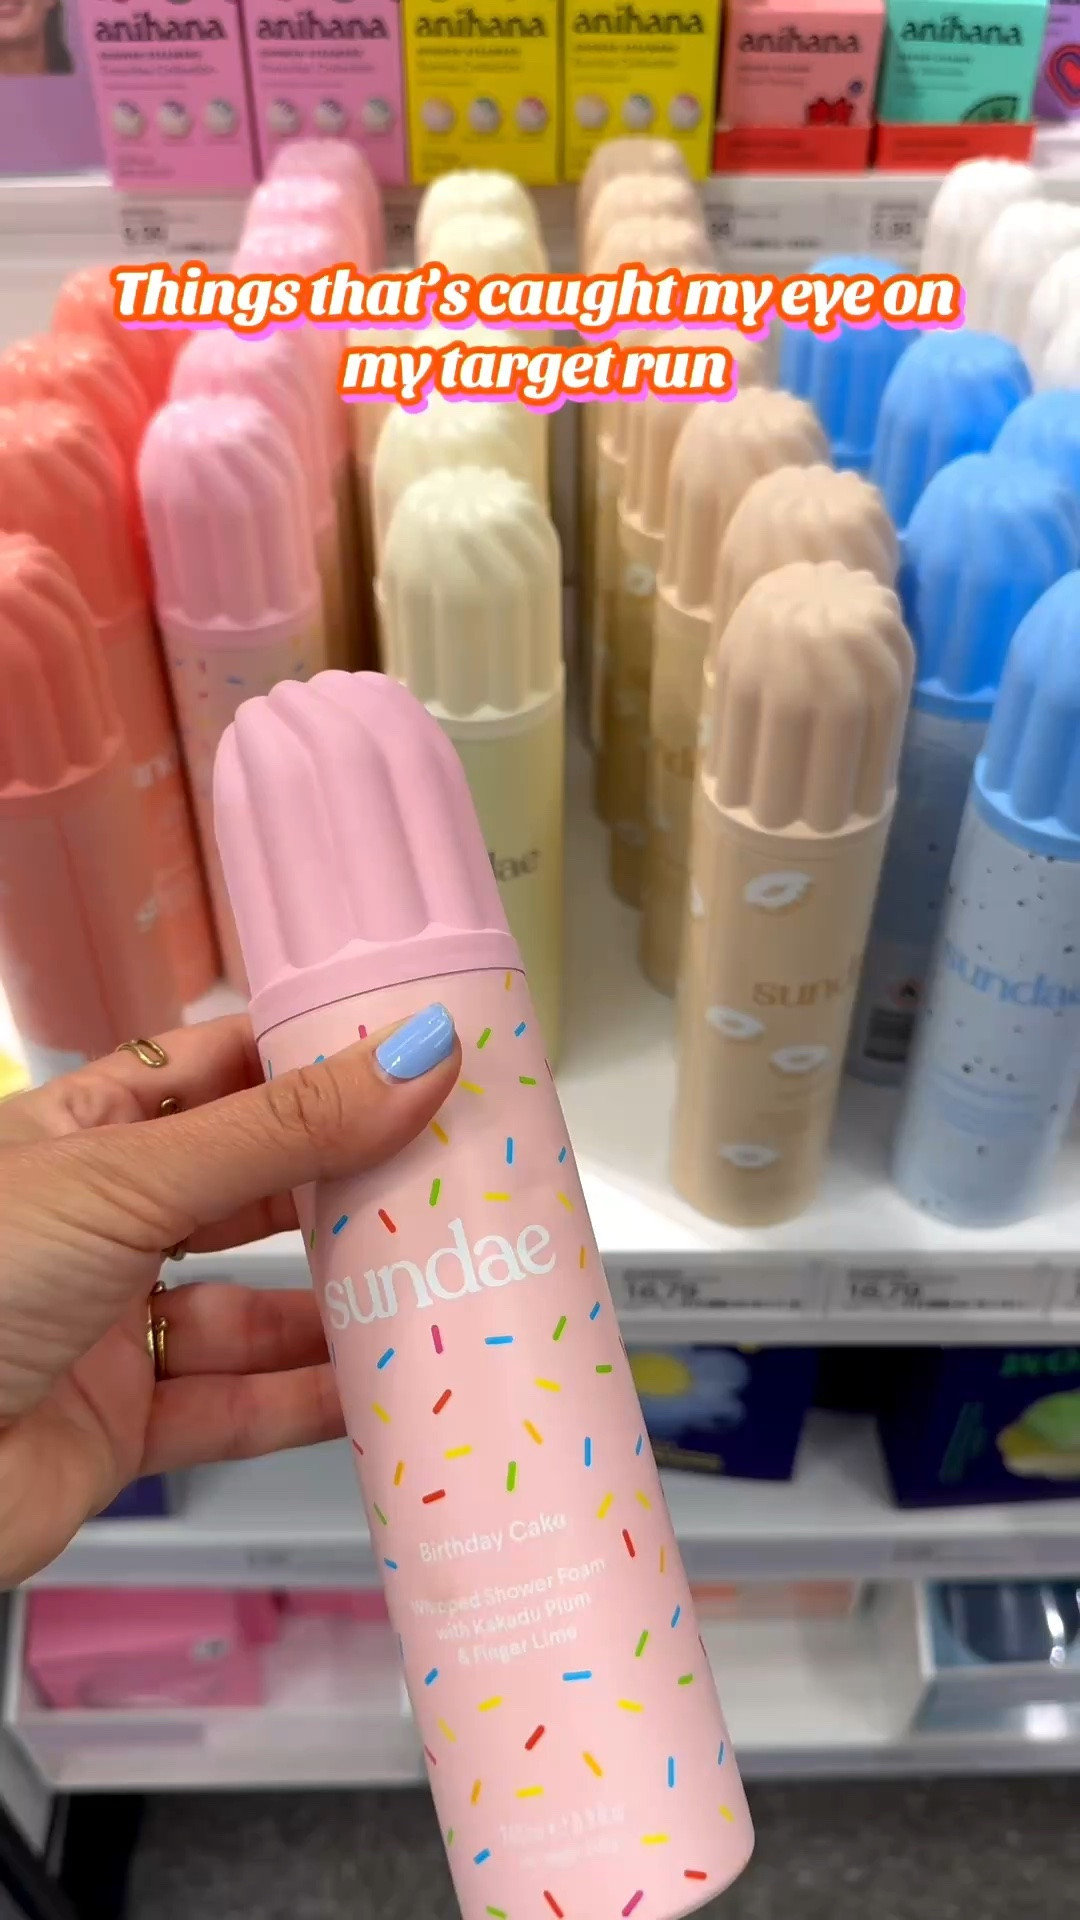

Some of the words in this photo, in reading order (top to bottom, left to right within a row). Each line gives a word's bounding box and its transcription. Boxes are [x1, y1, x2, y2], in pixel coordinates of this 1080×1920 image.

[95, 10, 227, 42] anihana
[257, 10, 390, 40] anihana
[415, 7, 547, 37] anihana
[574, 5, 704, 34] anihana
[900, 13, 1023, 46] anihana
[740, 25, 862, 53] anihana
[324, 1217, 557, 1330] sundae
[419, 1531, 504, 1563] Birthday
[509, 1512, 568, 1542] Cake
[484, 1575, 553, 1605] Shower
[557, 1557, 606, 1585] Foam
[436, 1620, 471, 1641] with
[545, 1591, 592, 1617] Plum
[473, 1638, 528, 1664] Finger
[532, 1626, 578, 1650] Lime
